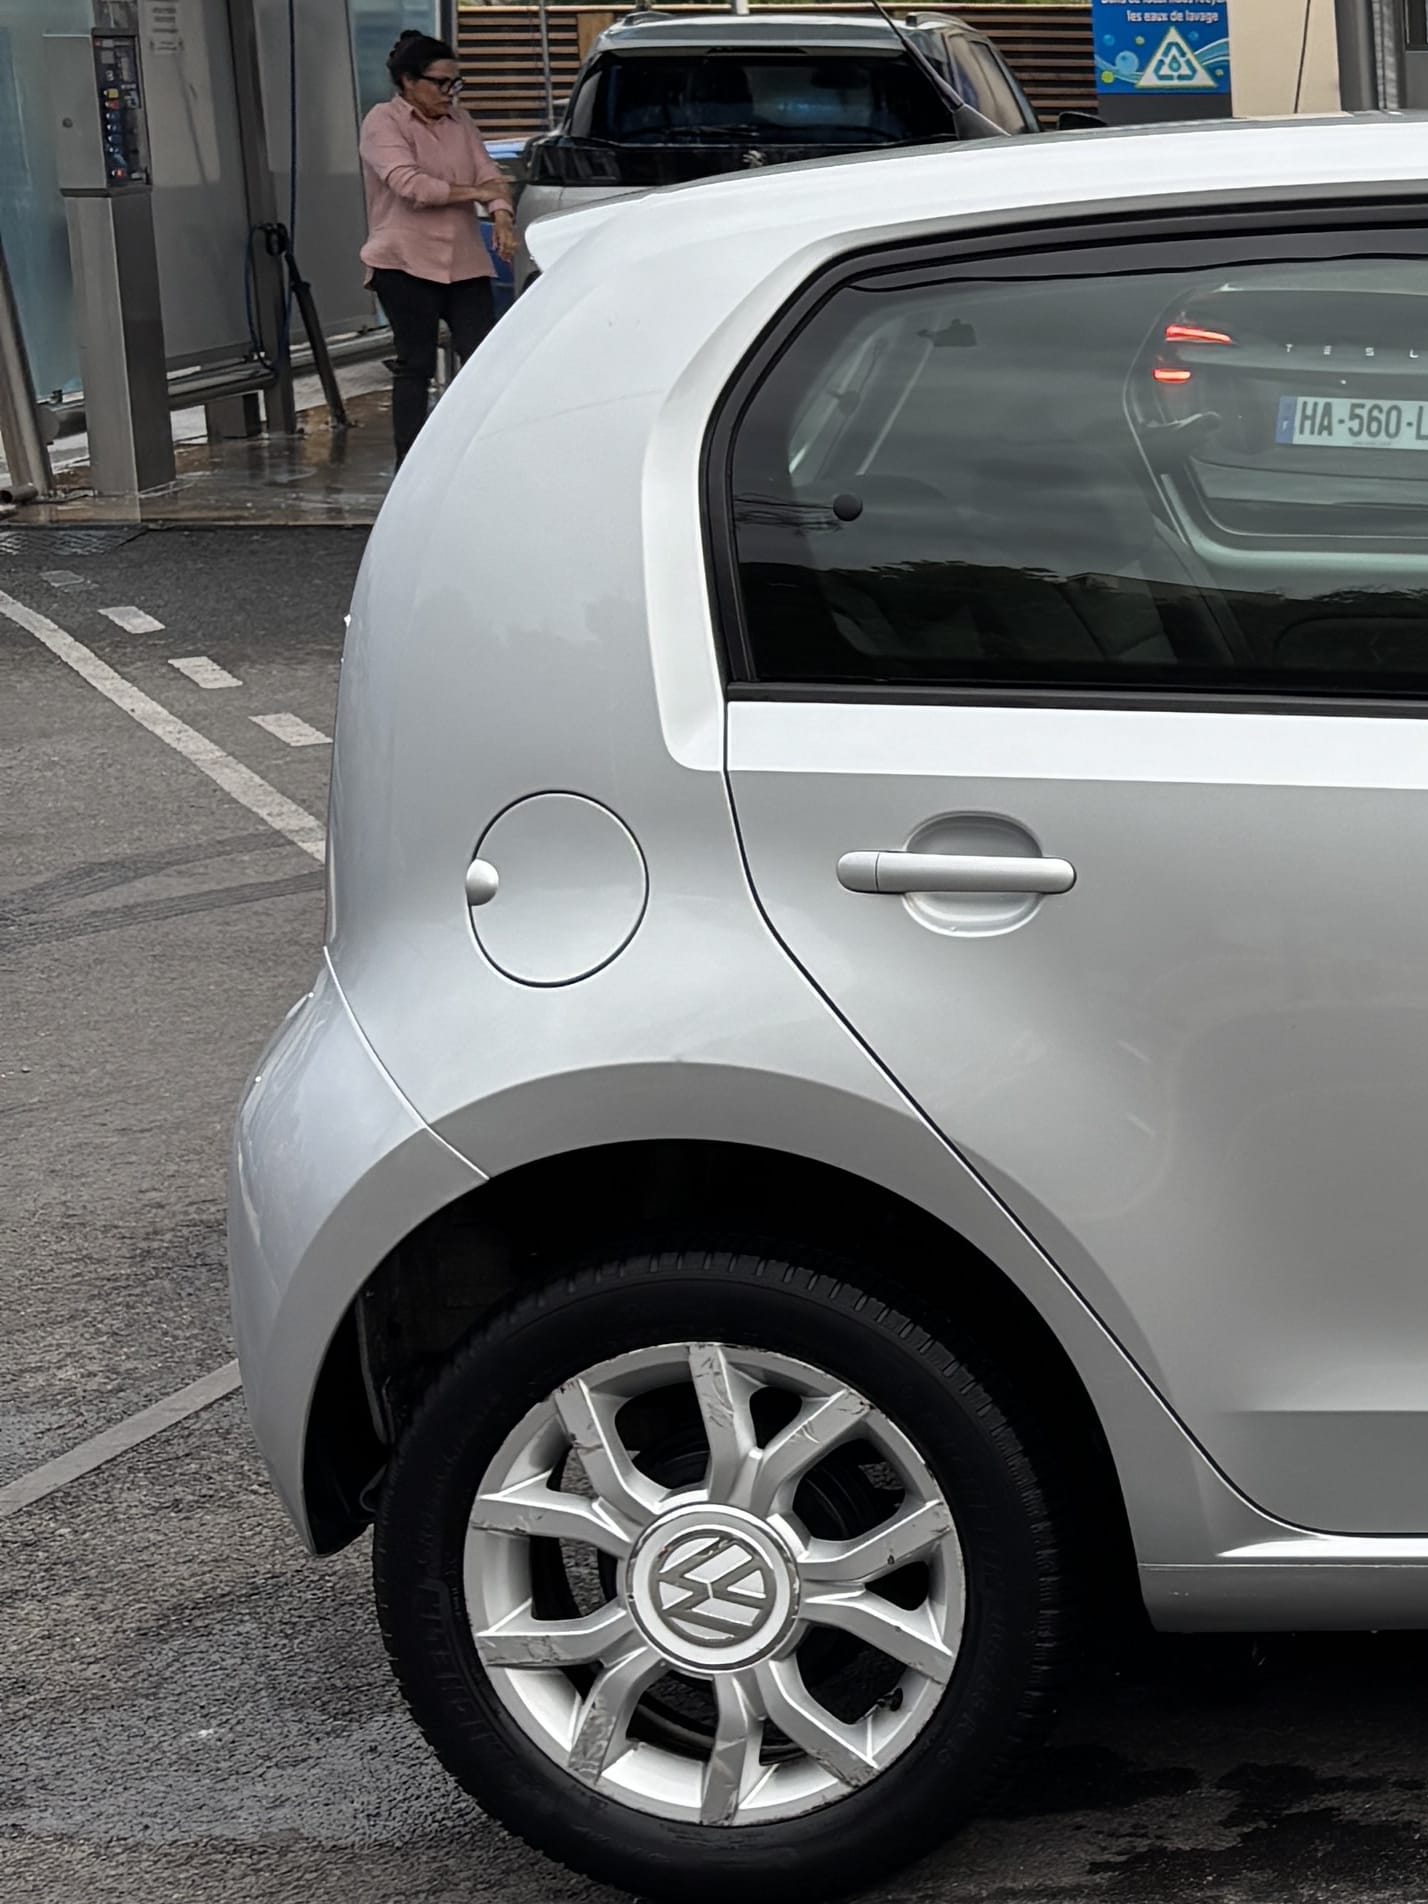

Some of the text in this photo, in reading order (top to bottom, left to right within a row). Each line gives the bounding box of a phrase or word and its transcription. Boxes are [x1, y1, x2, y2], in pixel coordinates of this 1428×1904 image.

[1127, 10, 1218, 24] les eaux de lavage
